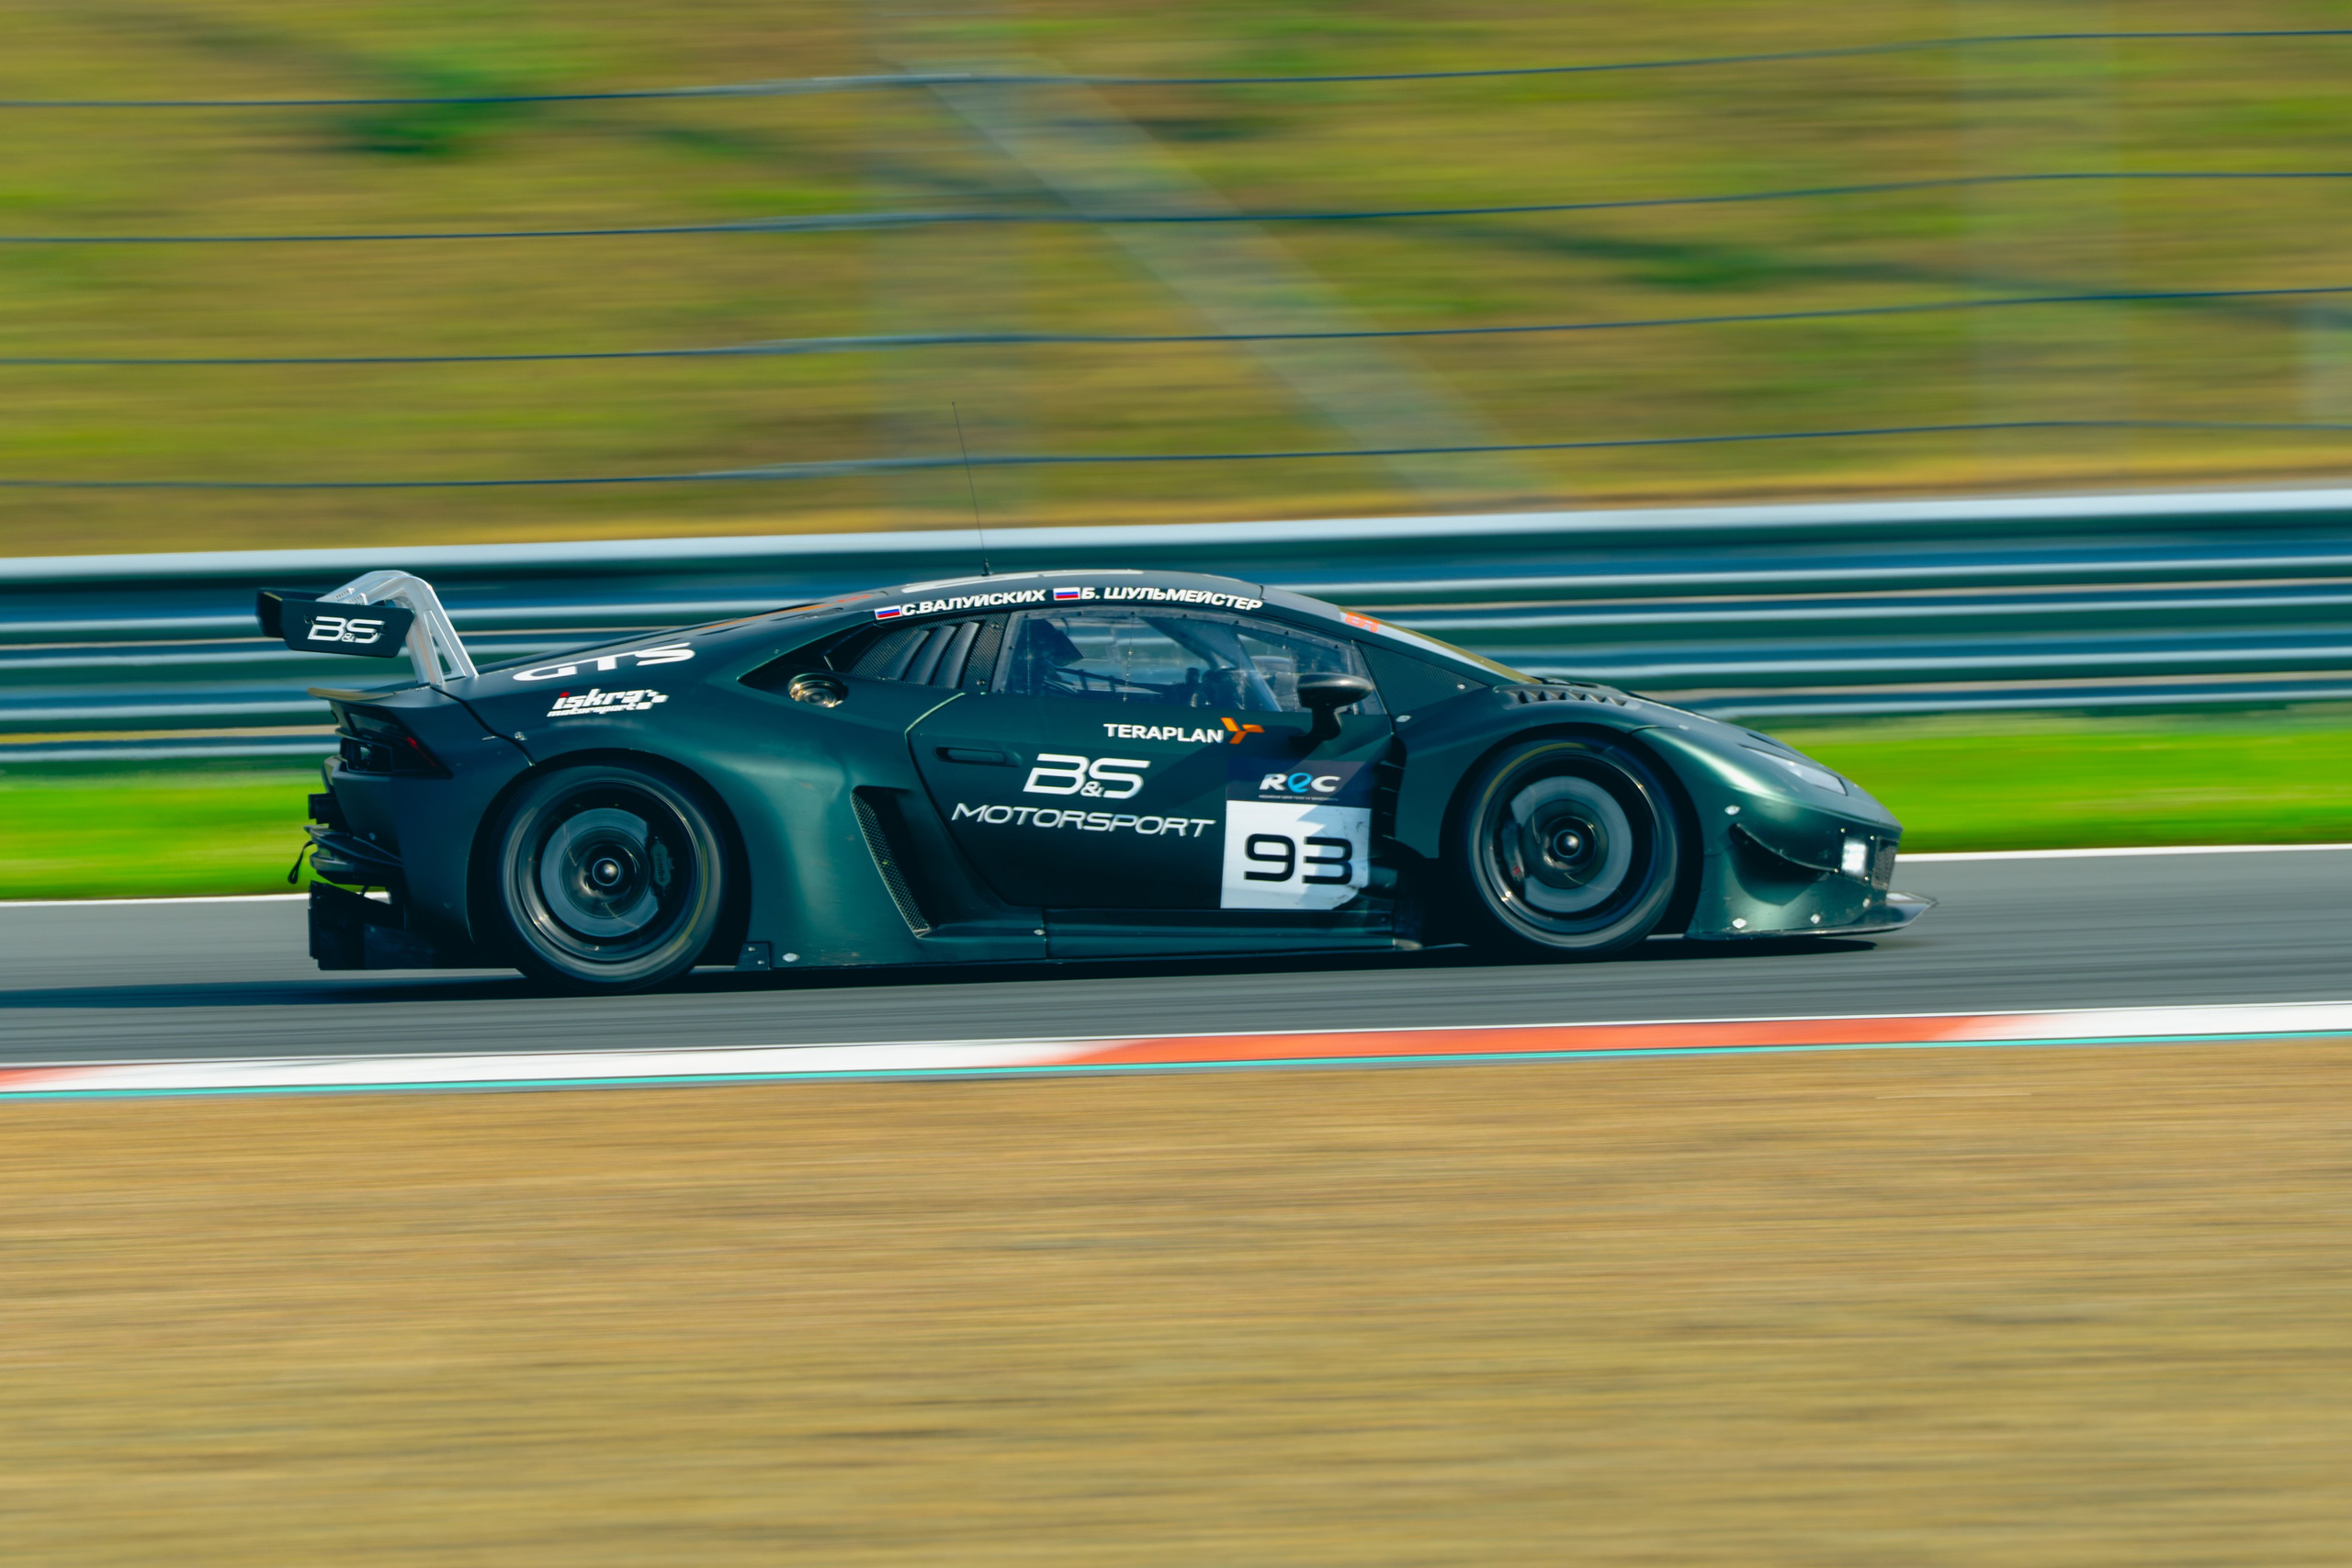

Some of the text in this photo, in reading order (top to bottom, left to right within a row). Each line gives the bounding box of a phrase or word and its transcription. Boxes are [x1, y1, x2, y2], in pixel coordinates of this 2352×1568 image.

[1081, 586, 1264, 611] Б. ШУЛЬМЕЙСТЕР
[307, 615, 386, 644] B&S
[512, 642, 696, 682] GTS
[551, 688, 645, 710] iskra
[1103, 722, 1224, 743] TERAPLAN
[1023, 753, 1151, 799] B&S
[951, 803, 1216, 838] MOTORSPORT
[1243, 832, 1354, 886] 93
